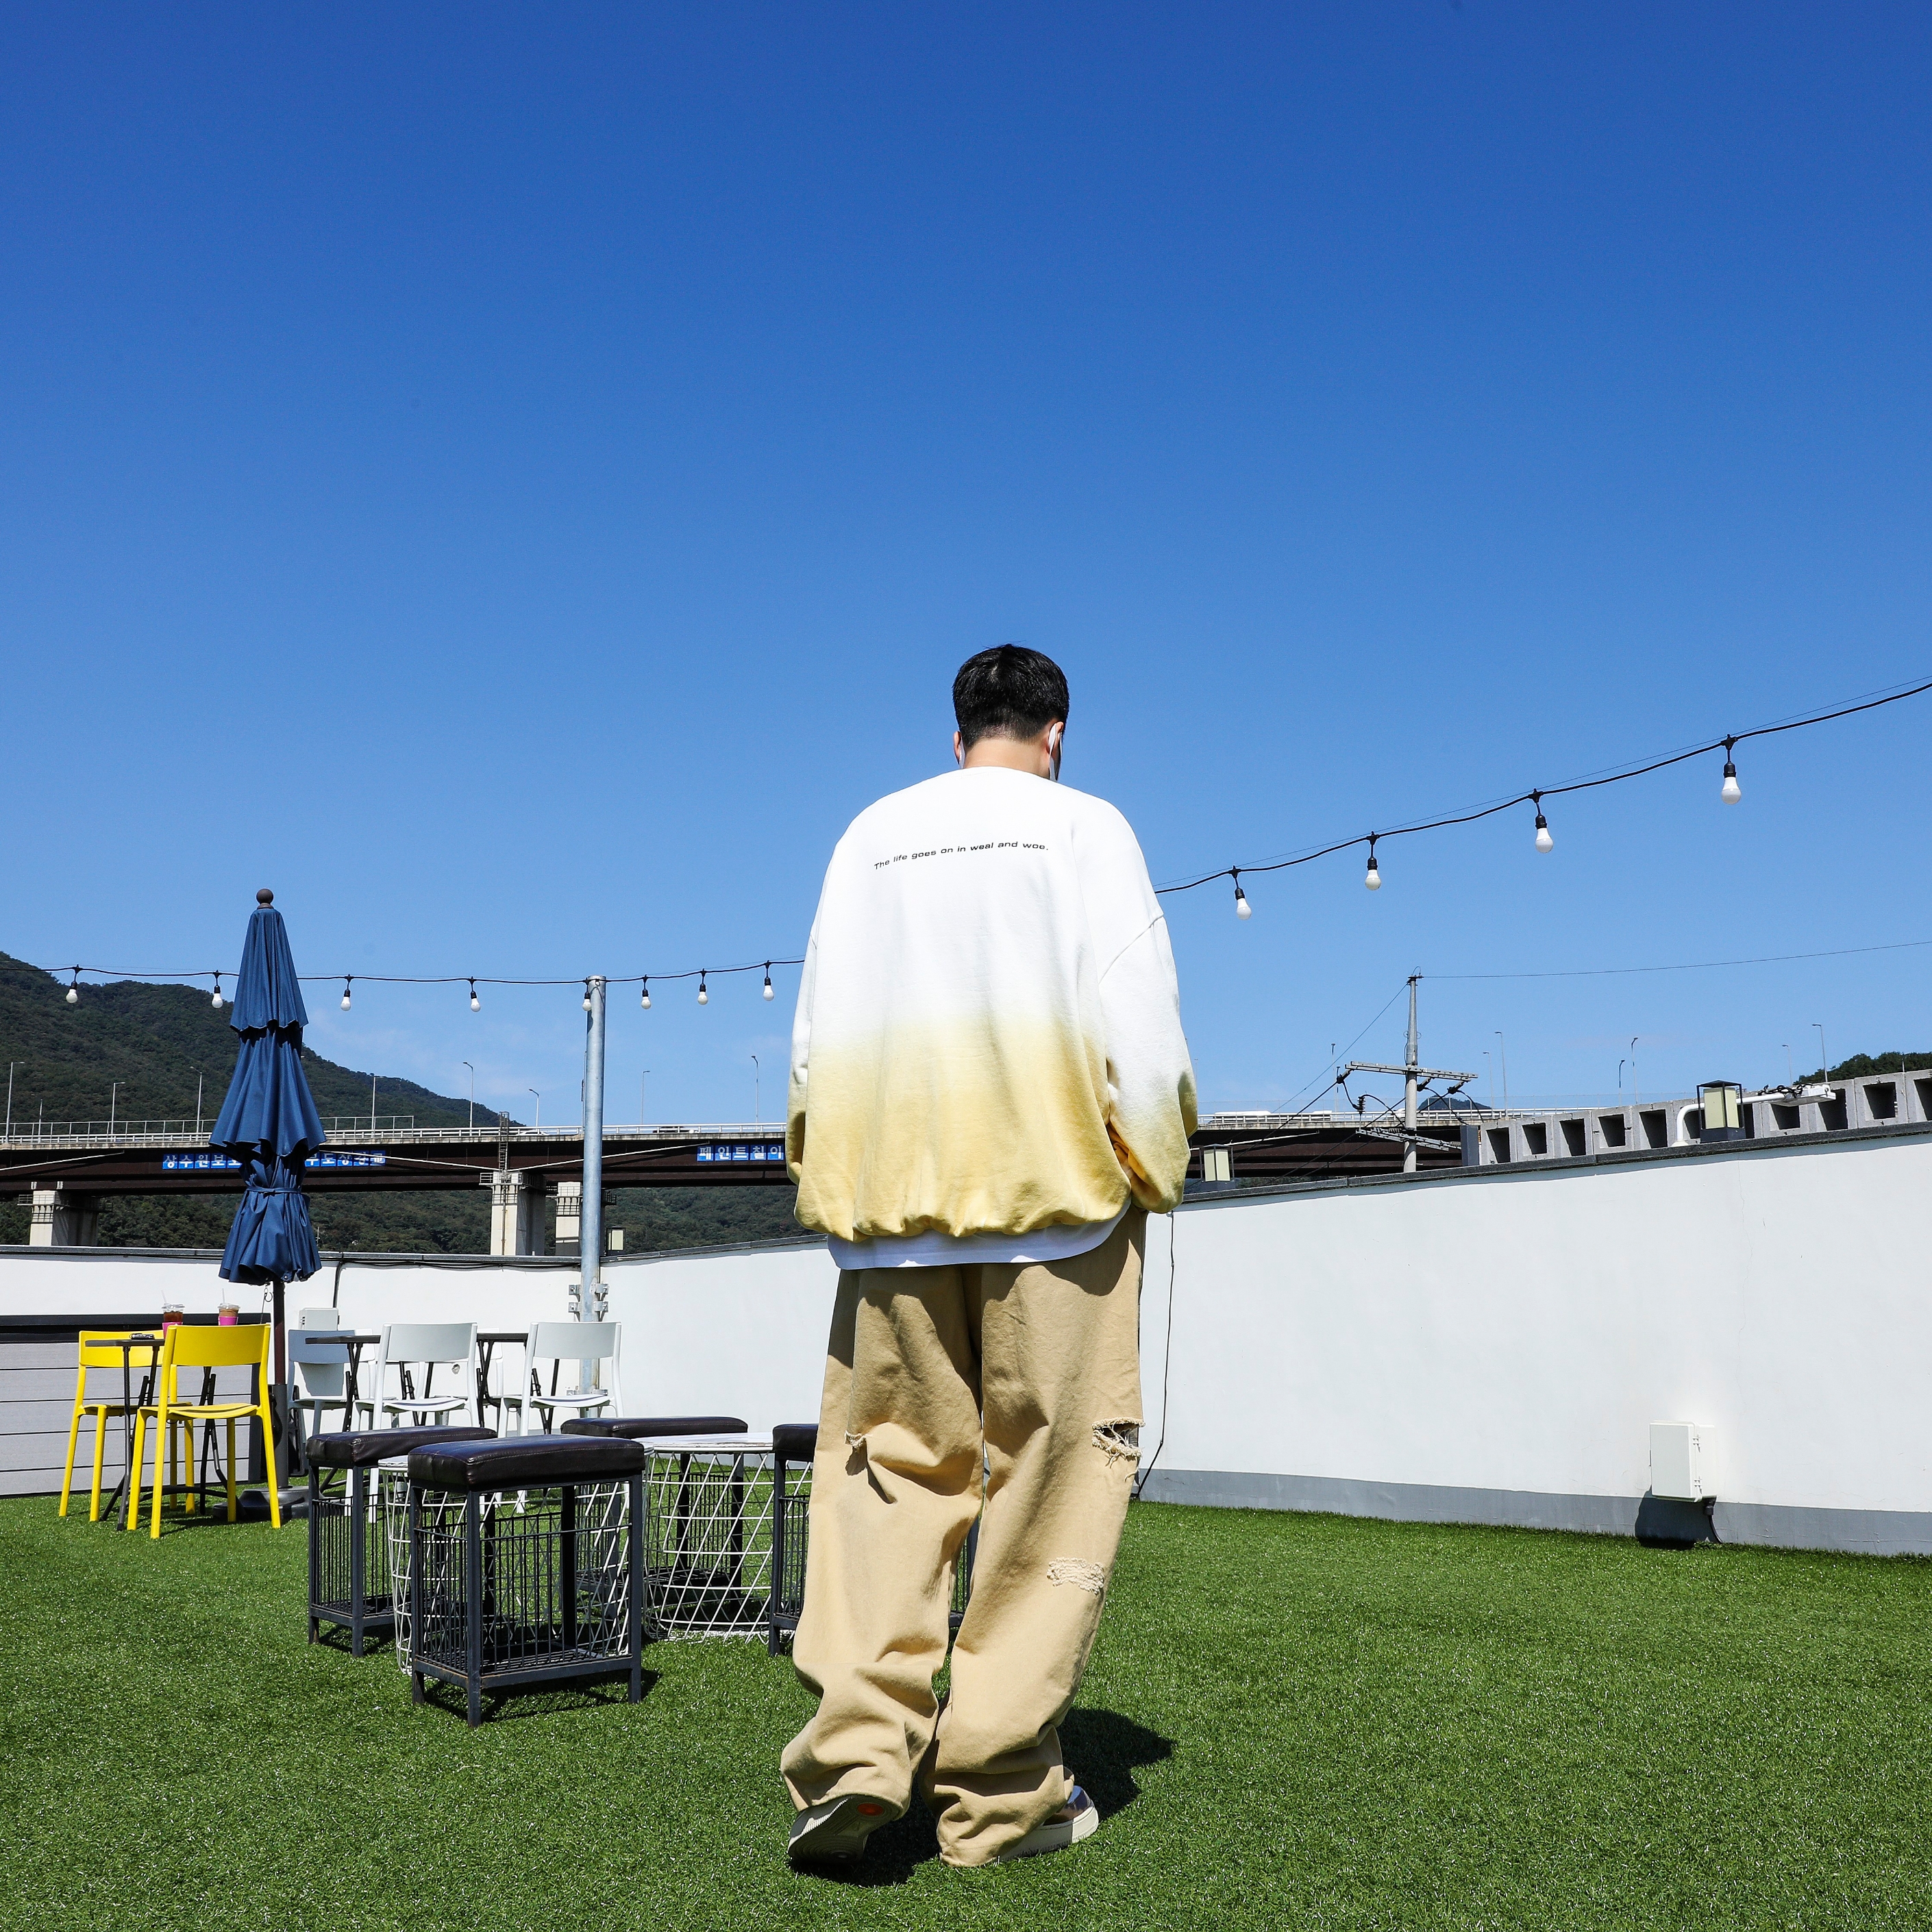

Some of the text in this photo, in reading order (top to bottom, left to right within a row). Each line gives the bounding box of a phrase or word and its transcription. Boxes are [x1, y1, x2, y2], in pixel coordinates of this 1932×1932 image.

[874, 860, 890, 870] The
[893, 854, 908, 863] life
[911, 850, 937, 860] goes
[970, 842, 994, 851] weal
[699, 1145, 782, 1160] 페인트칠이
